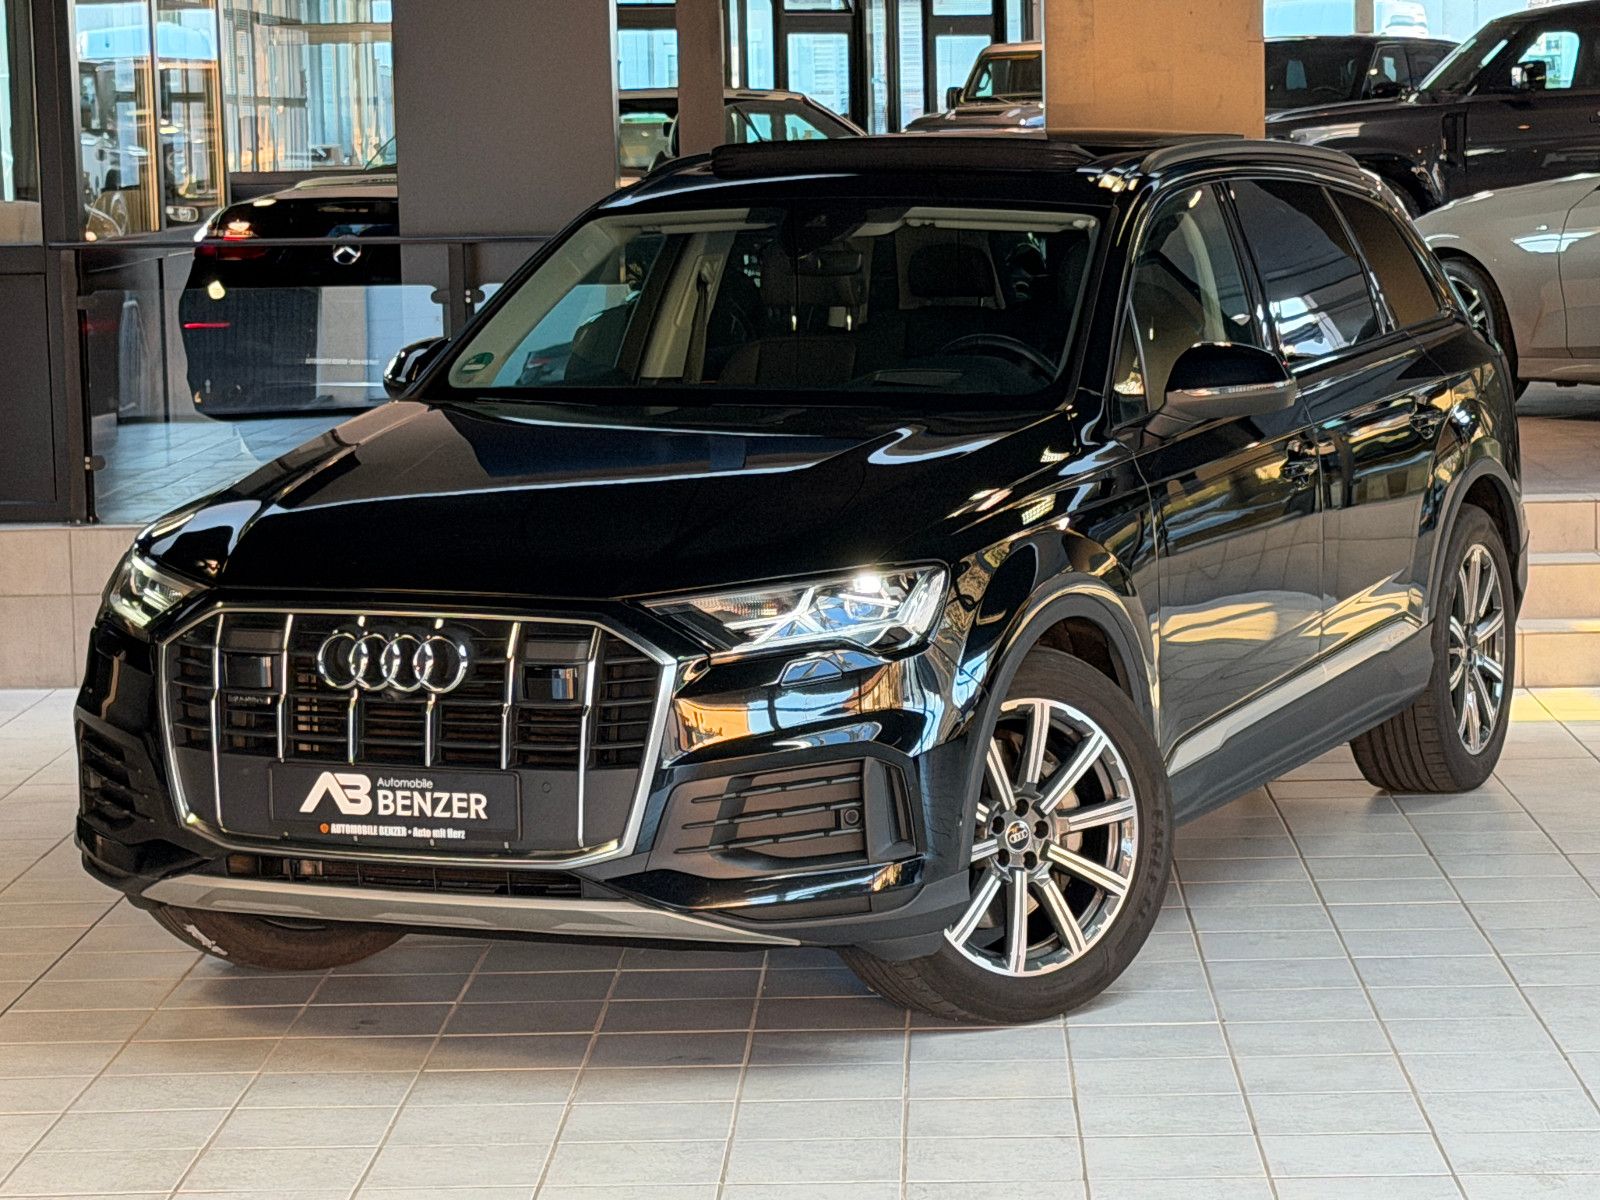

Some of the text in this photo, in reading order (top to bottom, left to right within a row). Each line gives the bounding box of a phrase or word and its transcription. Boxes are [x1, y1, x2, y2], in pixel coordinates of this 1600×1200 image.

[377, 777, 434, 789] Automobile
[377, 789, 488, 819] BENZER
[330, 823, 466, 840] AUTOMOBILE BENZER Auto mit Herz
